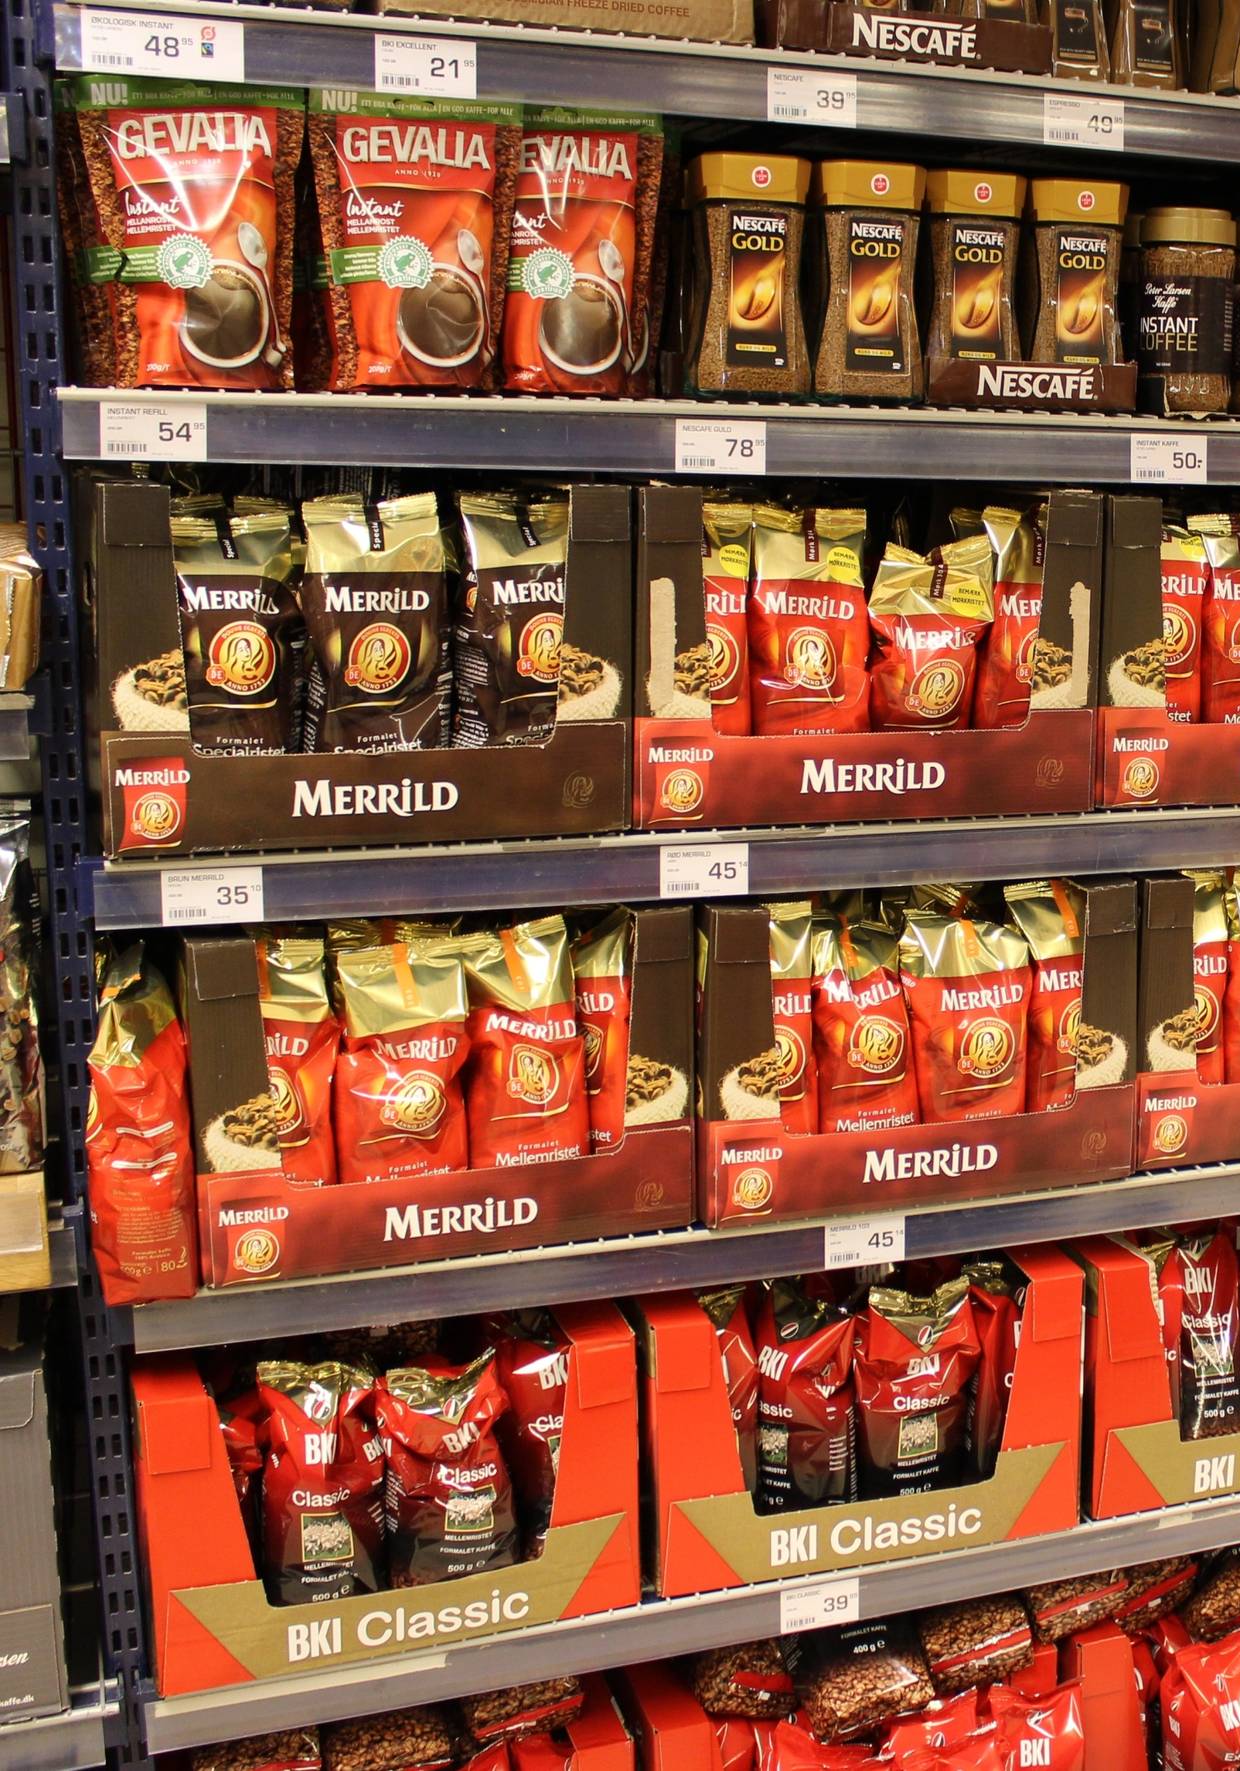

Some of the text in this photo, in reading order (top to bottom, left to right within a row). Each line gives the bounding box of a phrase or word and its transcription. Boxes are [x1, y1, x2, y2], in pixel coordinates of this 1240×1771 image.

[611, 1, 645, 13] DRIED
[647, 4, 690, 17] COFFEE
[91, 16, 174, 31] ØKOLOGISK INSTANT
[144, 35, 179, 57] 48
[852, 13, 978, 59] NESCAFÉ
[396, 42, 437, 52] EXCELLENT
[431, 57, 460, 79] 21
[90, 83, 128, 105] NU!
[322, 90, 357, 112] NU!
[816, 90, 845, 110] 39
[1087, 114, 1113, 134] 49
[117, 112, 272, 160] GEVALIA
[343, 125, 491, 170] GEVALIA
[346, 193, 405, 217] Instant
[732, 233, 784, 252] GOLD
[850, 239, 900, 258] GOLD
[954, 245, 1002, 264] GOLD
[1059, 252, 1105, 270] GOLD
[1141, 317, 1198, 334] INSTANT
[977, 365, 1094, 400] NESCAFÉ
[107, 408, 168, 416] INSTANT REFILL
[158, 422, 192, 442] 54
[683, 425, 713, 433] NESCAFE
[726, 438, 754, 458] 78
[1162, 440, 1179, 448] KAFFE
[216, 736, 264, 745] Formalet
[357, 732, 398, 744] Formalet
[168, 873, 224, 882] BRUN MERRILD
[708, 861, 737, 880] 45
[217, 885, 248, 906] 35
[836, 1111, 914, 1132] Mellemristet
[495, 1144, 580, 1166] Mellemristet
[868, 1230, 894, 1248] 45
[1184, 1267, 1213, 1294] BKI
[1182, 1313, 1232, 1329] Classic
[758, 1343, 788, 1381] BKI
[893, 1394, 949, 1412] Classic
[442, 1422, 479, 1454] BKI
[304, 1433, 338, 1465] BKI
[441, 1463, 497, 1486] Classic
[1193, 1455, 1234, 1494] BKI
[292, 1488, 350, 1508] Classic
[444, 1531, 493, 1542] MELLEMRISTET
[770, 1503, 982, 1567] BKI Classic
[440, 1546, 476, 1554] FORMALET
[823, 1595, 849, 1613] 39
[287, 1590, 529, 1662] BKI Classic
[1020, 1737, 1051, 1767] BKI
